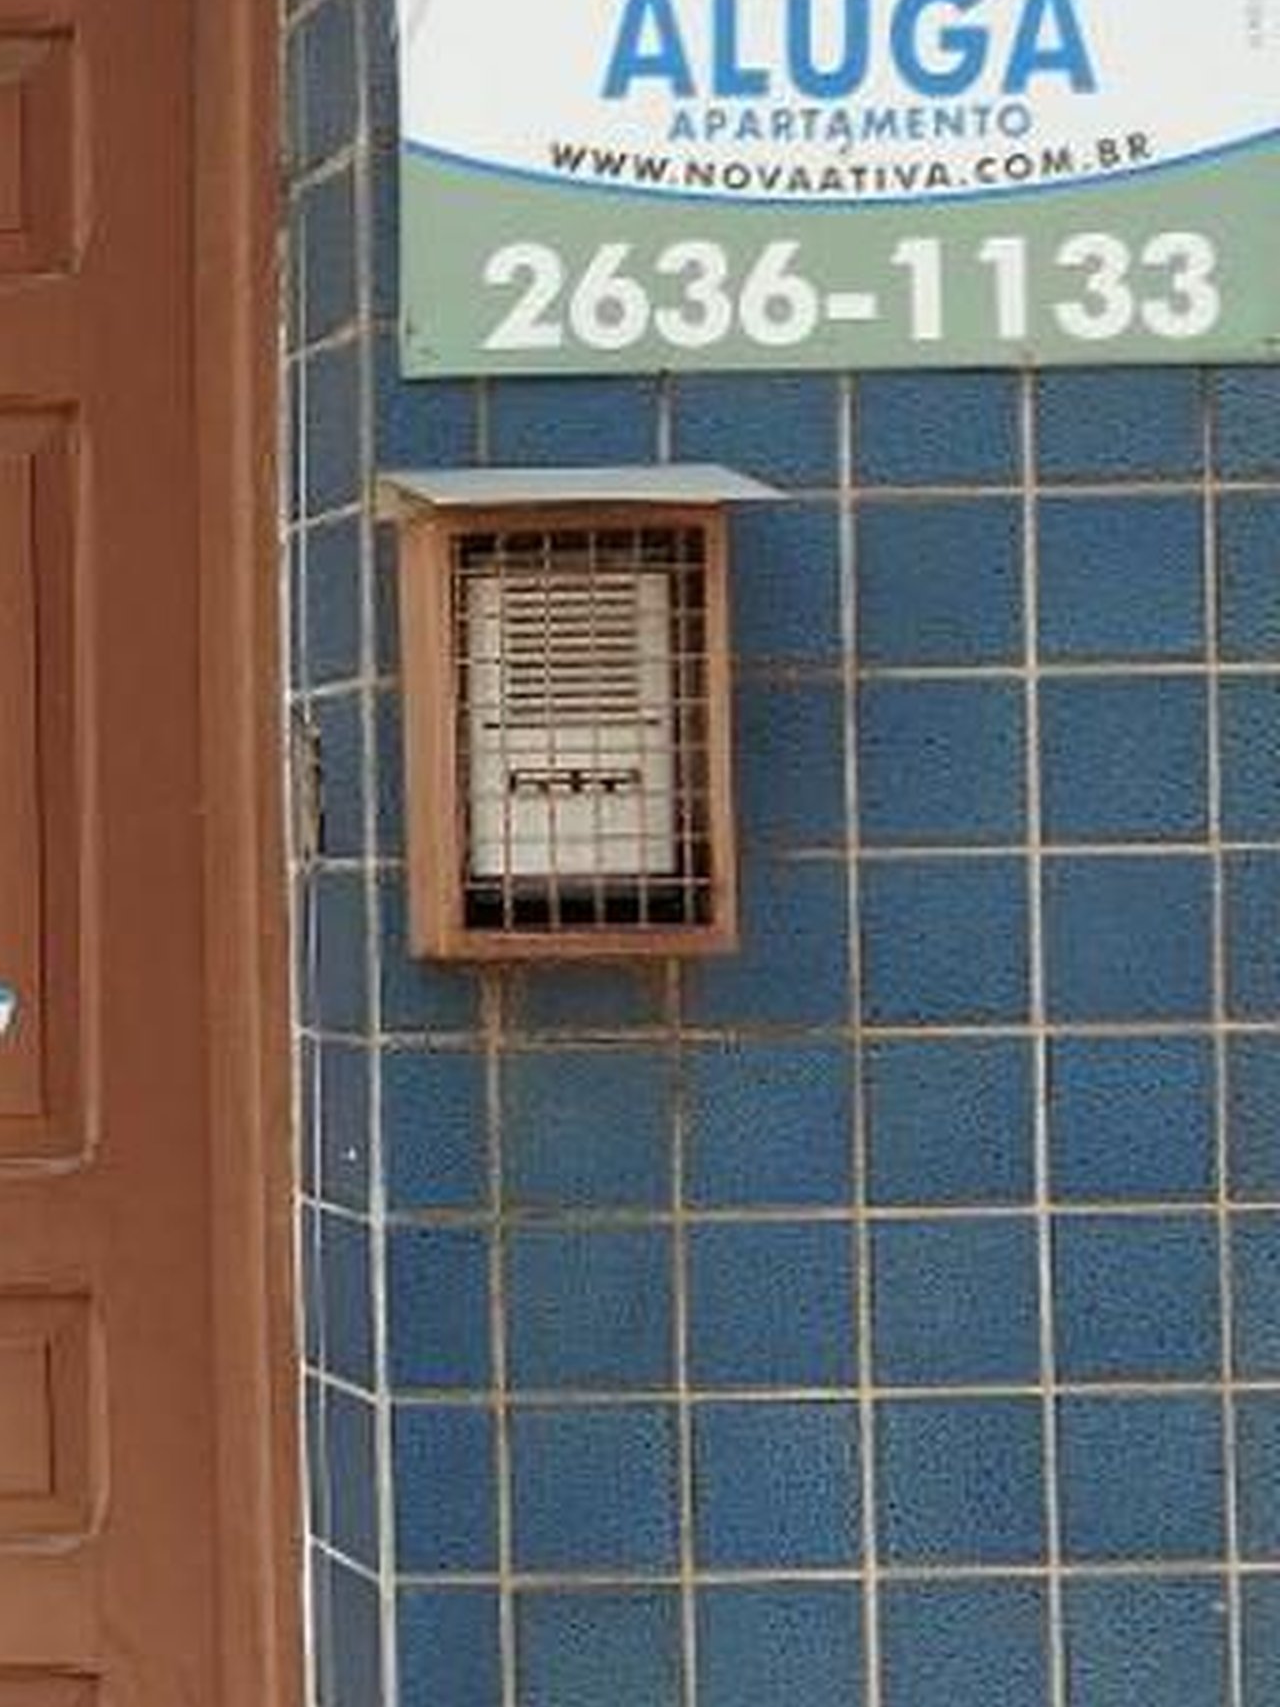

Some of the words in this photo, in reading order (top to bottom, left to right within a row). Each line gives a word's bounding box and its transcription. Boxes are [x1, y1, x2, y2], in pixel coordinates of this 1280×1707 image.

[668, 103, 1034, 144] APARTAMENTO
[549, 131, 1153, 194] WWW.NOVAATIVA.COM.BR
[479, 230, 1222, 352] 2636-1133
